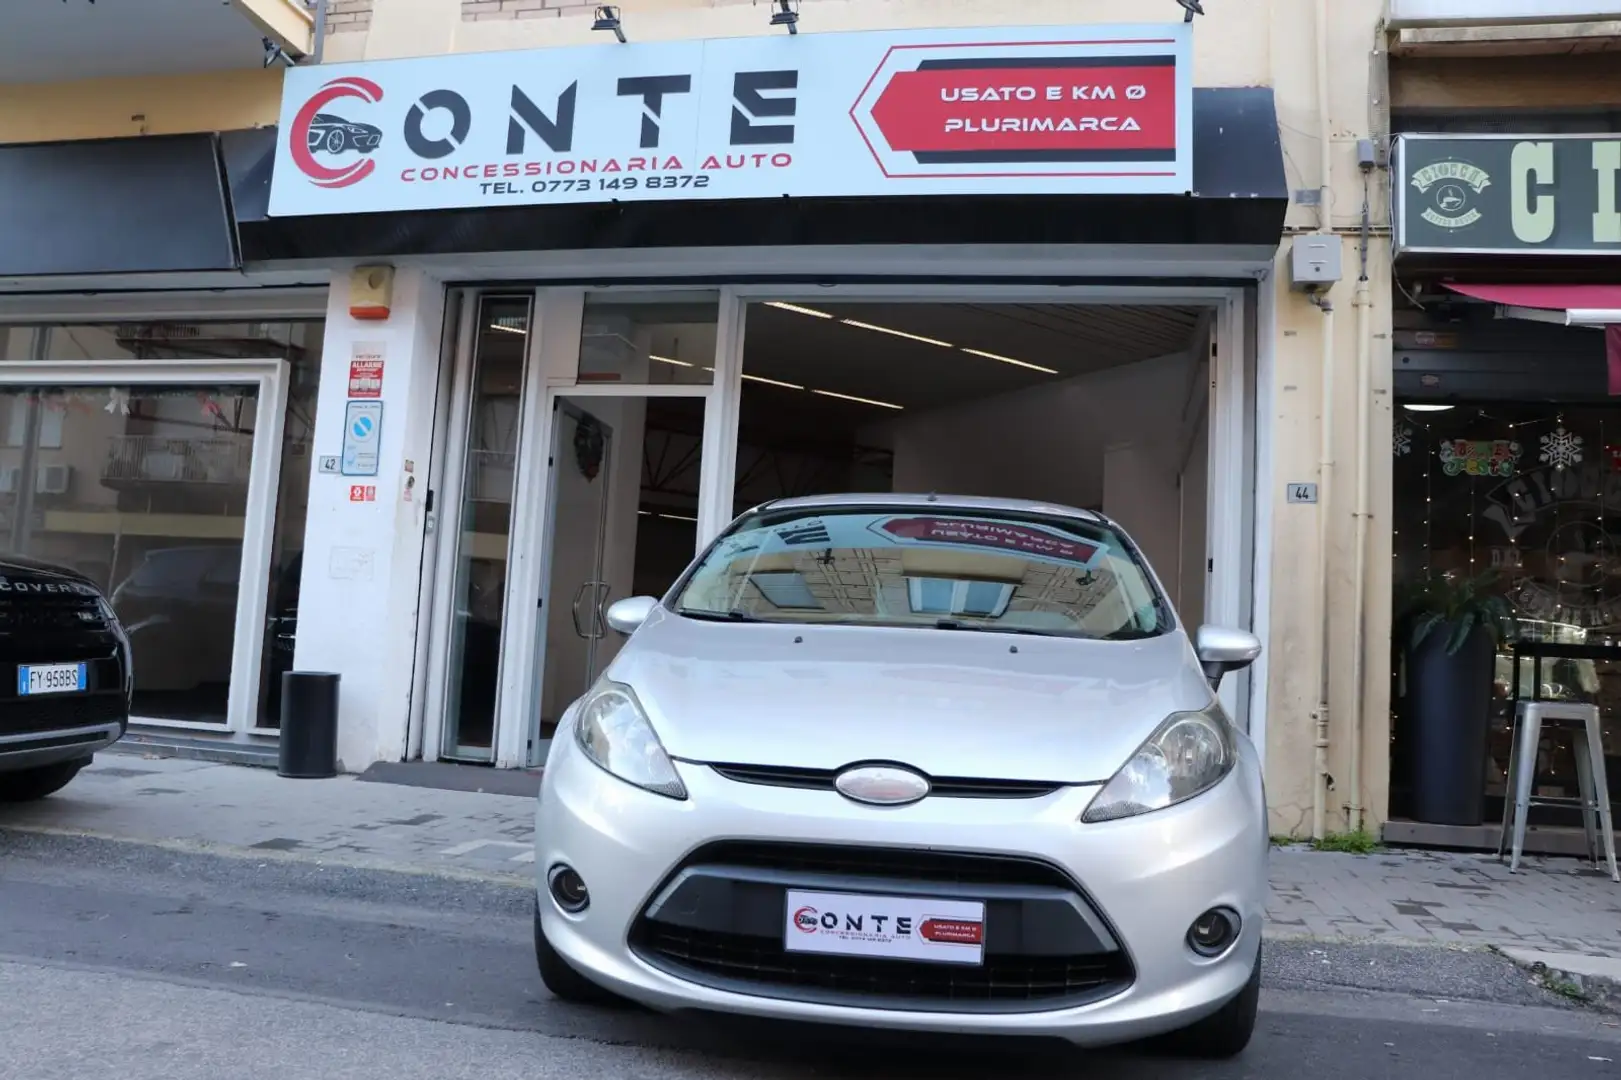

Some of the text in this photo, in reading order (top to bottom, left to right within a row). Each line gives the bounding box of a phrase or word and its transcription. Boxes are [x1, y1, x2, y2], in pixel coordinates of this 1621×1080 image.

[941, 86, 1036, 102] USATO
[1046, 85, 1063, 100] E
[1073, 85, 1115, 100] KM
[944, 116, 1141, 133] PLURIMARCA
[401, 152, 793, 182] CONCESSIONARIA AUTO
[479, 174, 710, 195] TEL. 0773 149 8372
[324, 458, 336, 470] 42
[1295, 487, 1309, 499] 44
[30, 671, 43, 688] FY
[47, 670, 78, 688] 958BS
